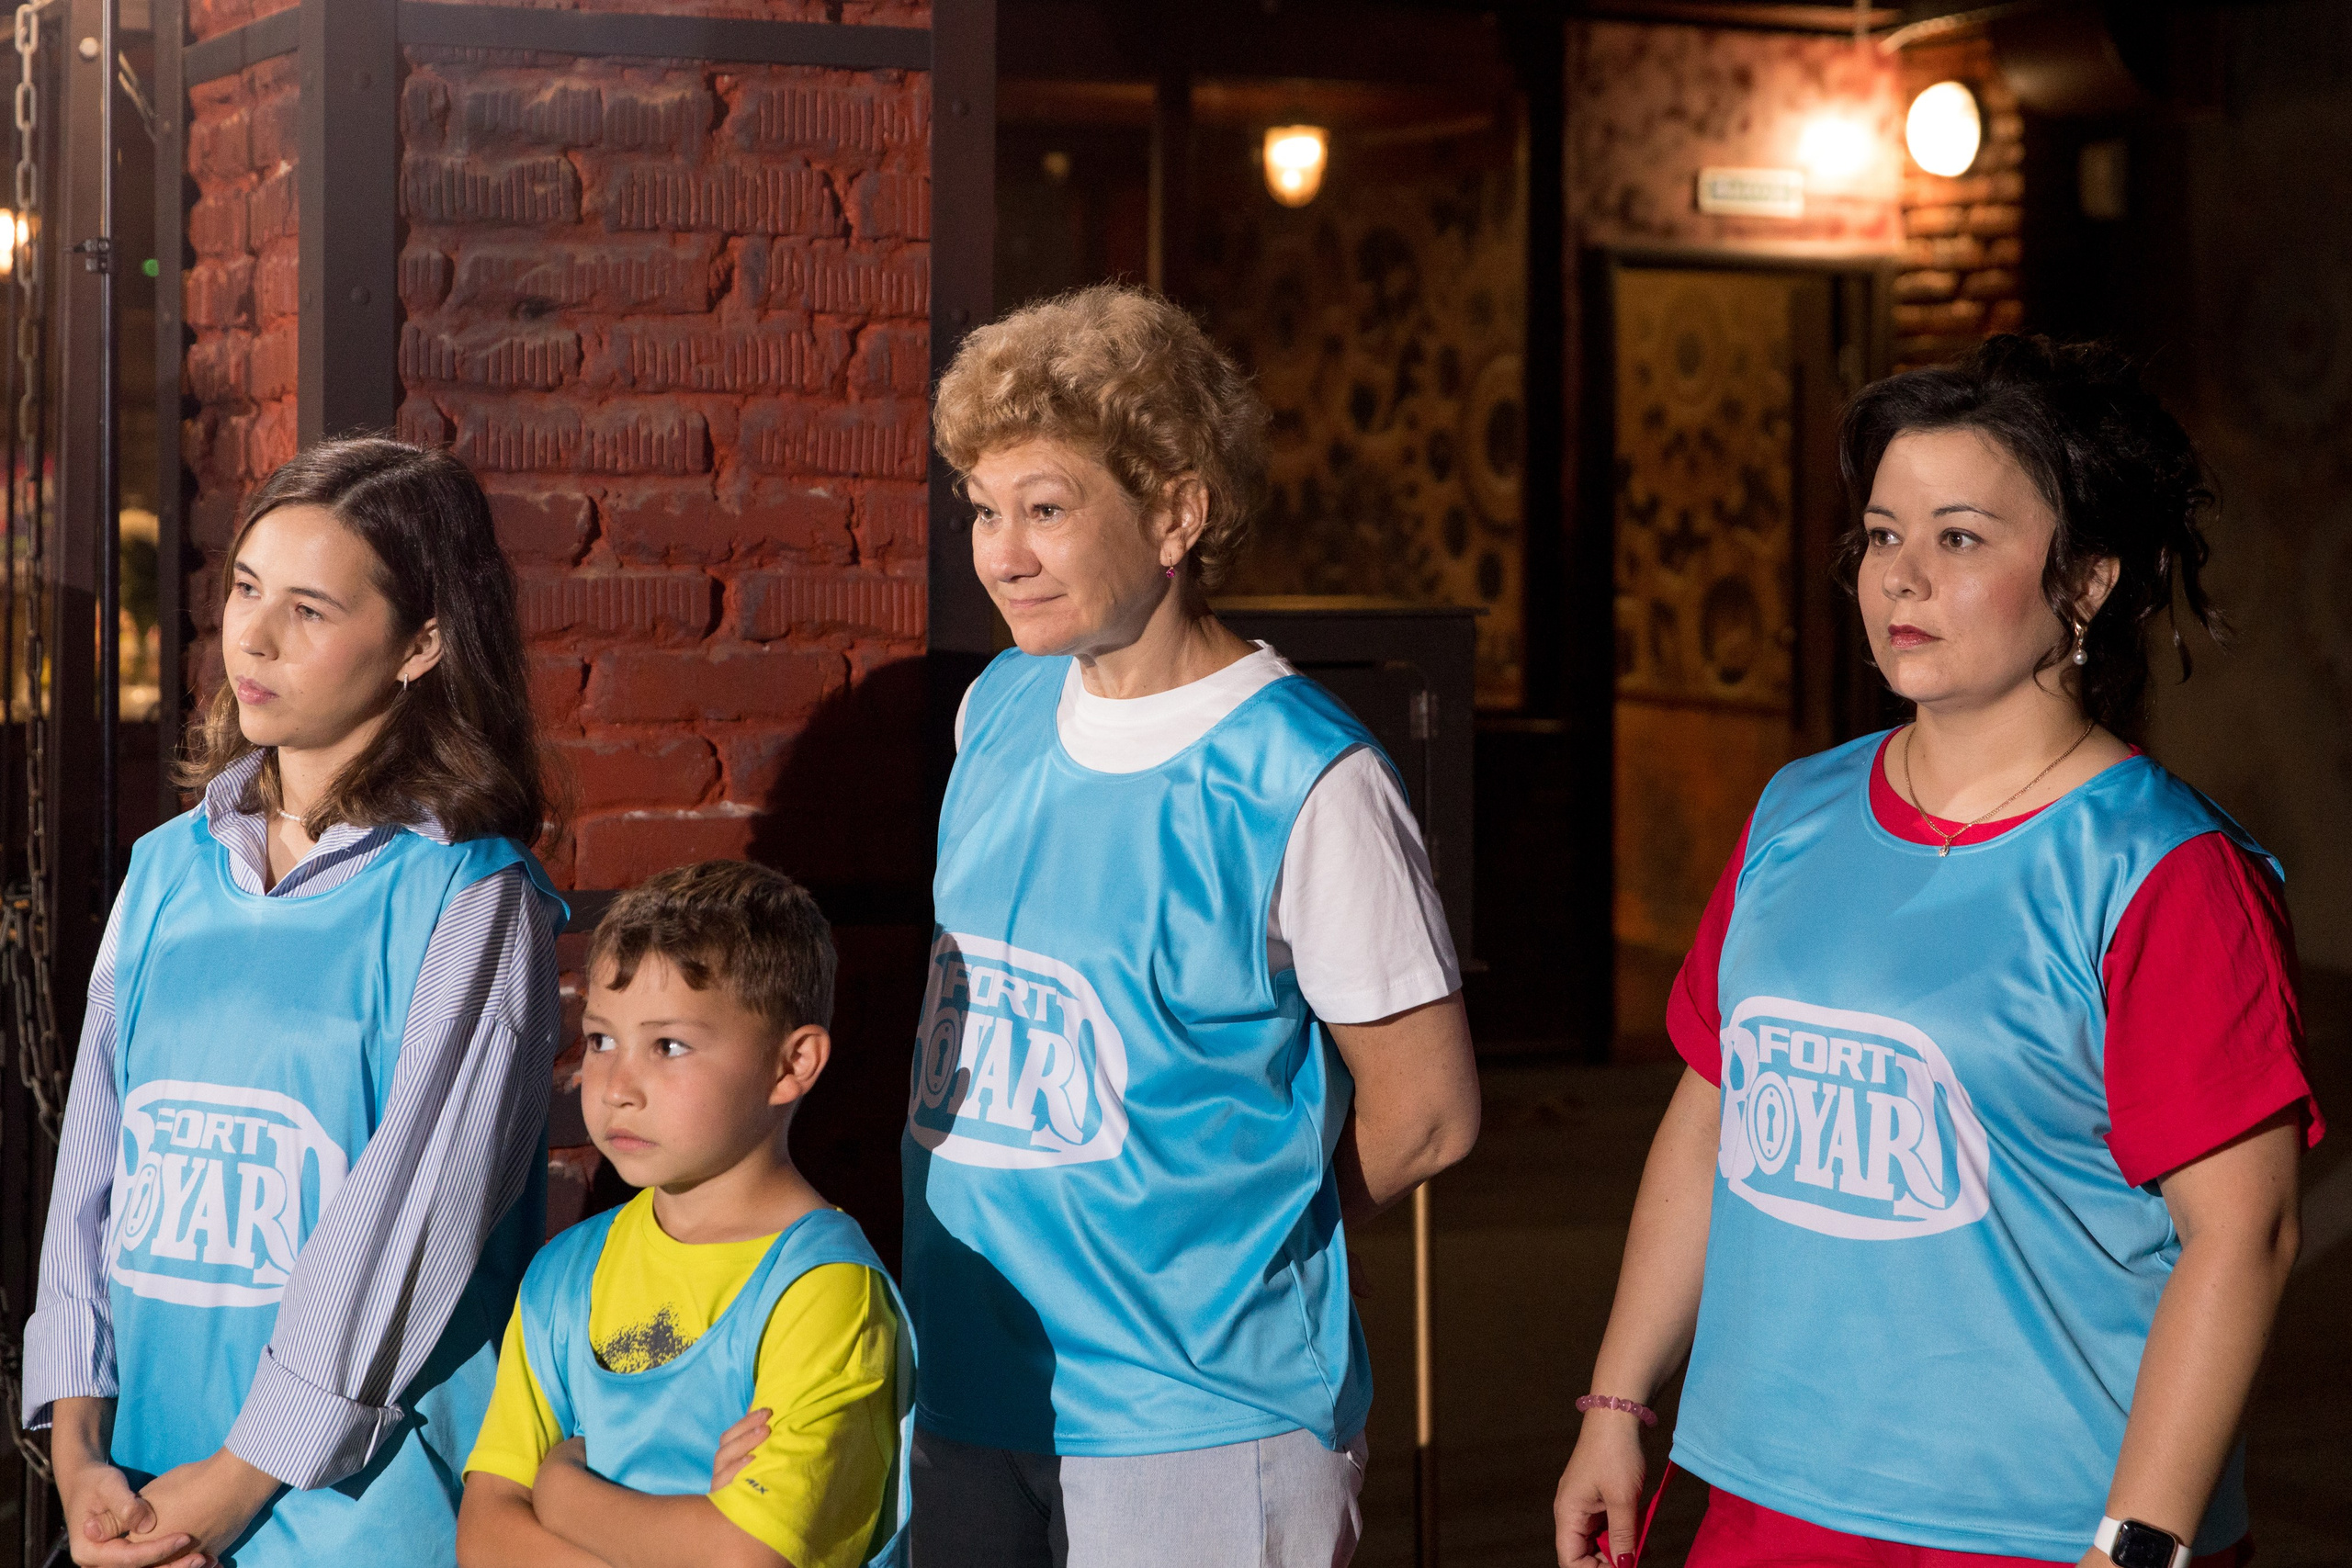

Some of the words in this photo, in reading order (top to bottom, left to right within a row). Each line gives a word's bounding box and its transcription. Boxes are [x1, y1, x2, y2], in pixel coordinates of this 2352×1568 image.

[941, 960, 1057, 1022] FORT
[1758, 1024, 1895, 1084] FORT
[155, 1108, 268, 1155] FORT
[1718, 1026, 1990, 1219] BOYARD
